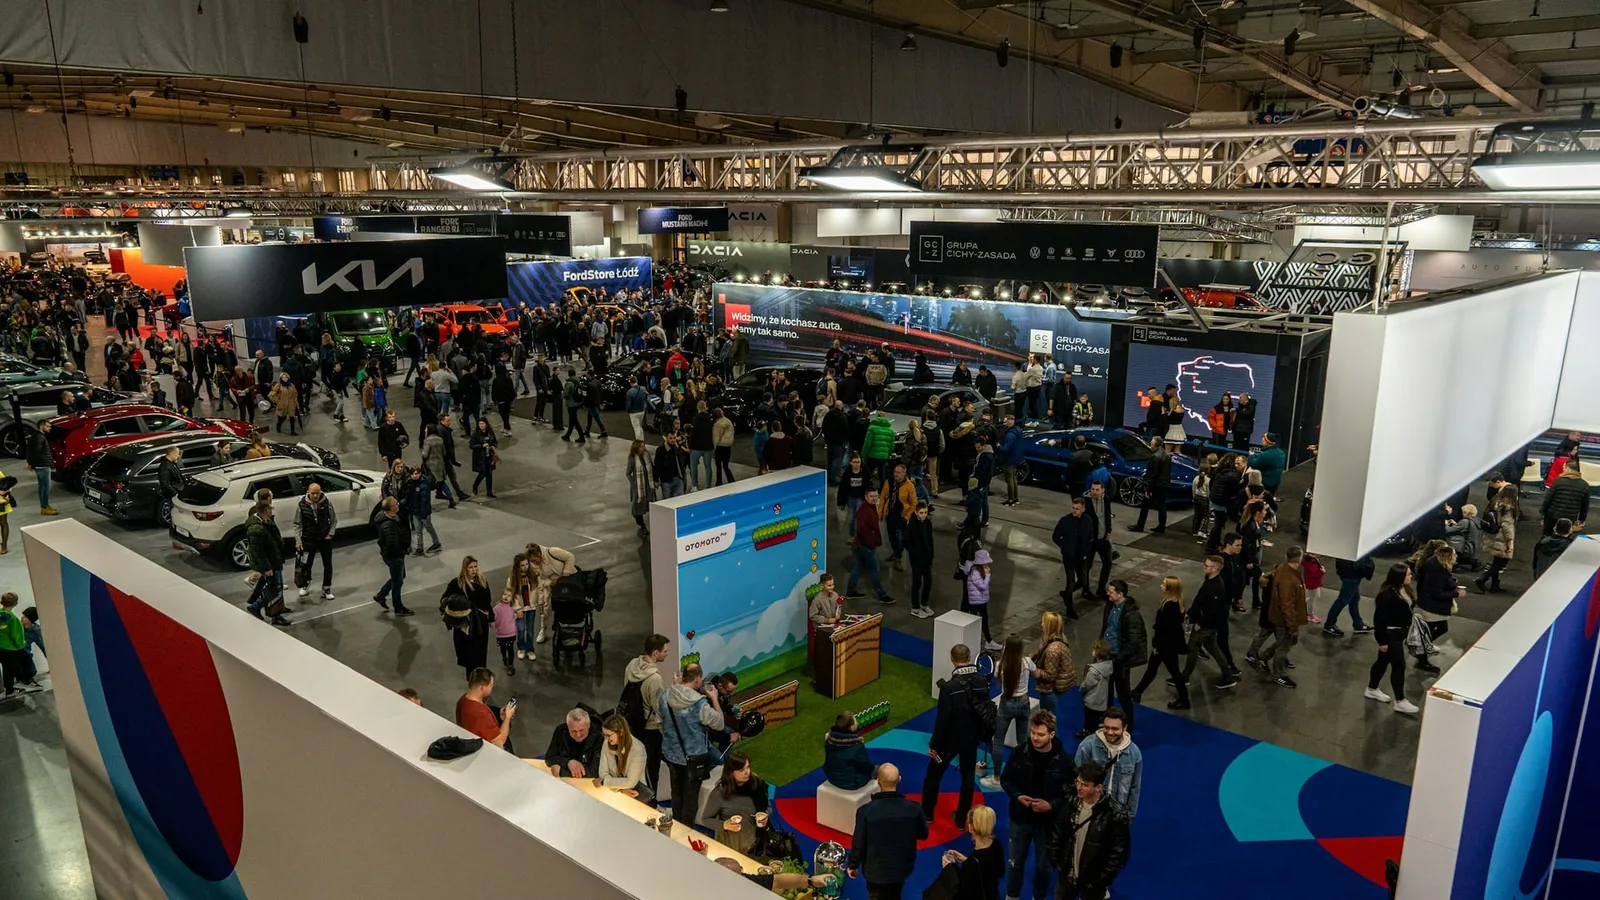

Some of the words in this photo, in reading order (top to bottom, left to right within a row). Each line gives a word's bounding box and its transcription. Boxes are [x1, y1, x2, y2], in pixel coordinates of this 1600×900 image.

[728, 211, 767, 221] ACIA
[420, 225, 451, 234] RANGER
[662, 220, 688, 228] MUSTANG
[689, 245, 743, 257] DACIA
[946, 241, 979, 250] GRUPA
[946, 250, 1017, 260] CICHY-ZASADA
[301, 257, 425, 295] KIA
[563, 270, 615, 281] FordStore
[616, 267, 639, 278] Łódź
[731, 311, 768, 325] Widzimy,
[769, 316, 780, 325] że
[780, 317, 818, 329] kochasz
[819, 321, 843, 331] auta.
[731, 324, 757, 336] Mamy
[757, 327, 772, 336] tak
[772, 330, 800, 339] samo.
[1056, 335, 1088, 345] GRUPA
[685, 536, 720, 551] OTOMOTO
